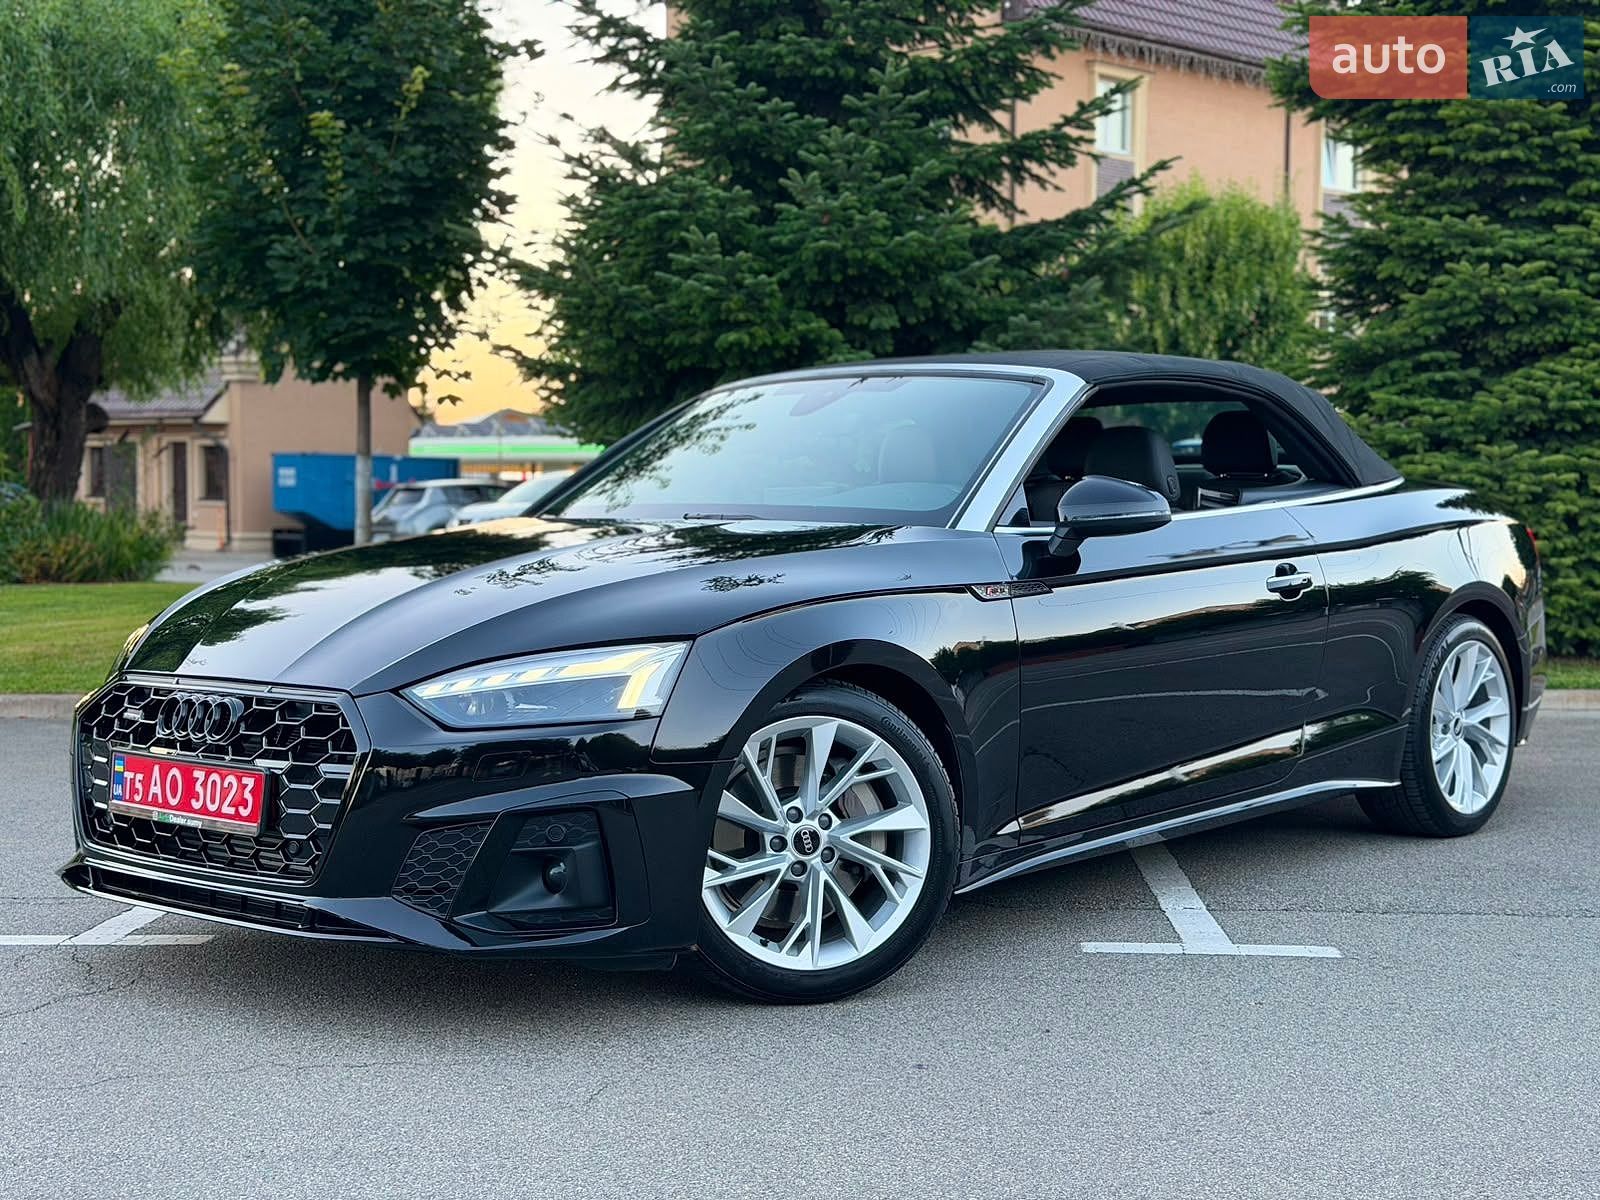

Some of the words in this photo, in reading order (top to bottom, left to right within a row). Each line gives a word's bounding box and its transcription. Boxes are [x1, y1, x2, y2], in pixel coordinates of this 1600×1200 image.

[113, 784, 123, 796] UA
[148, 765, 183, 806] AO
[190, 769, 256, 817] 3023
